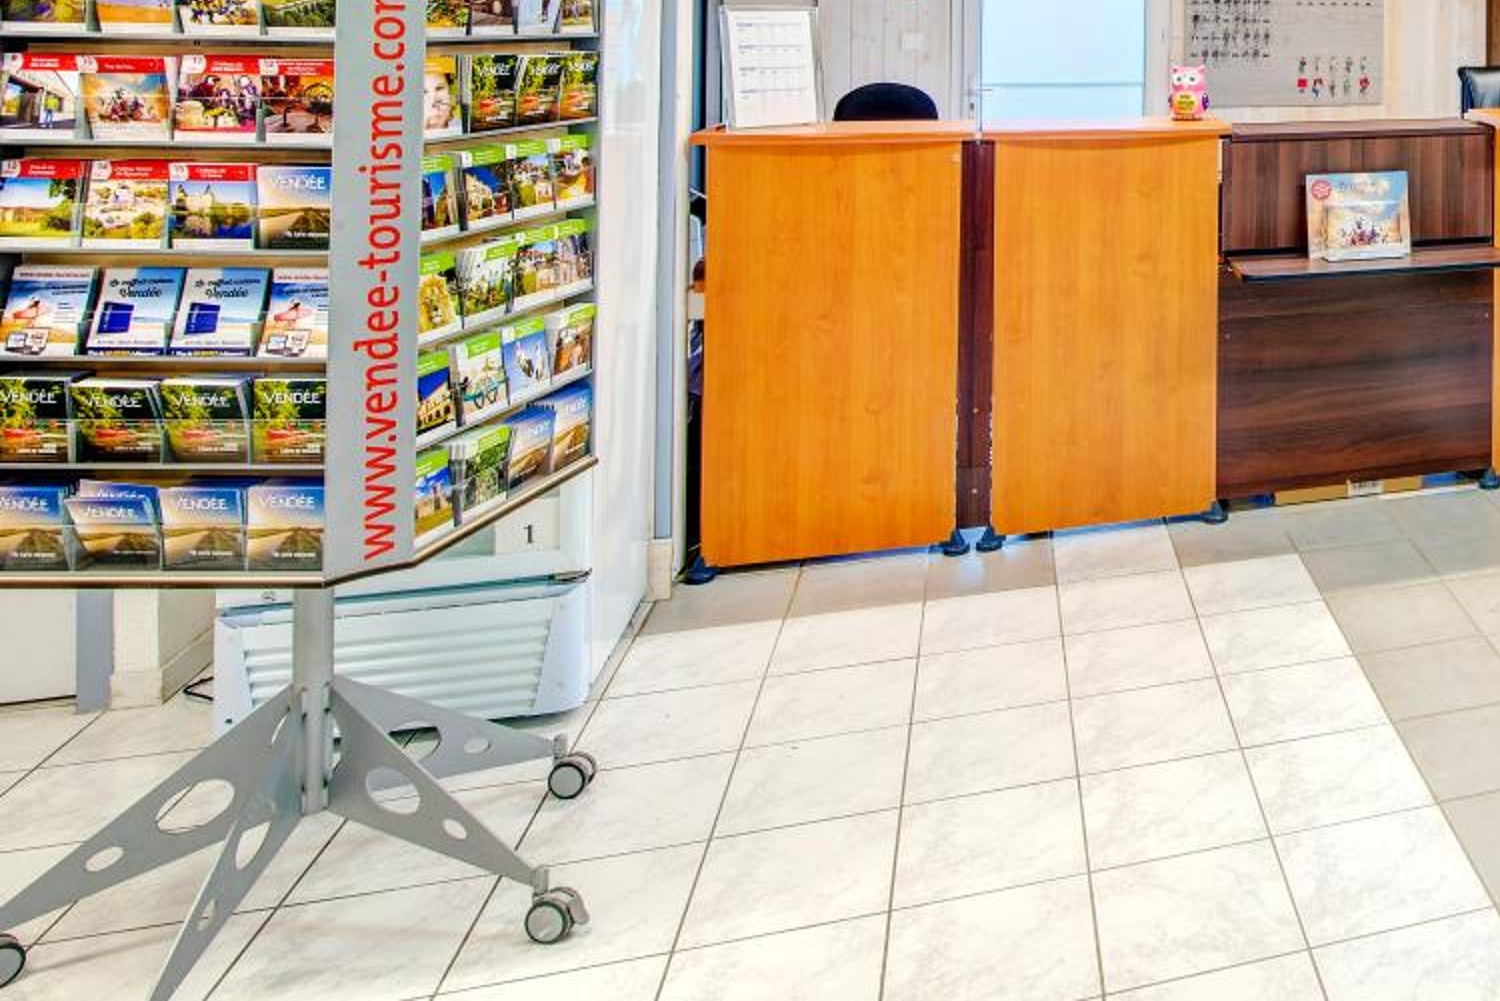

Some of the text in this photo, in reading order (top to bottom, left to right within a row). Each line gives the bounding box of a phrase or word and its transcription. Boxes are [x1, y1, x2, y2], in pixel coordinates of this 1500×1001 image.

[1, 388, 57, 404] VENDÉE
[263, 388, 321, 404] VENDÉE
[176, 495, 229, 511] VENDÉE
[259, 493, 316, 509] VENDÉE
